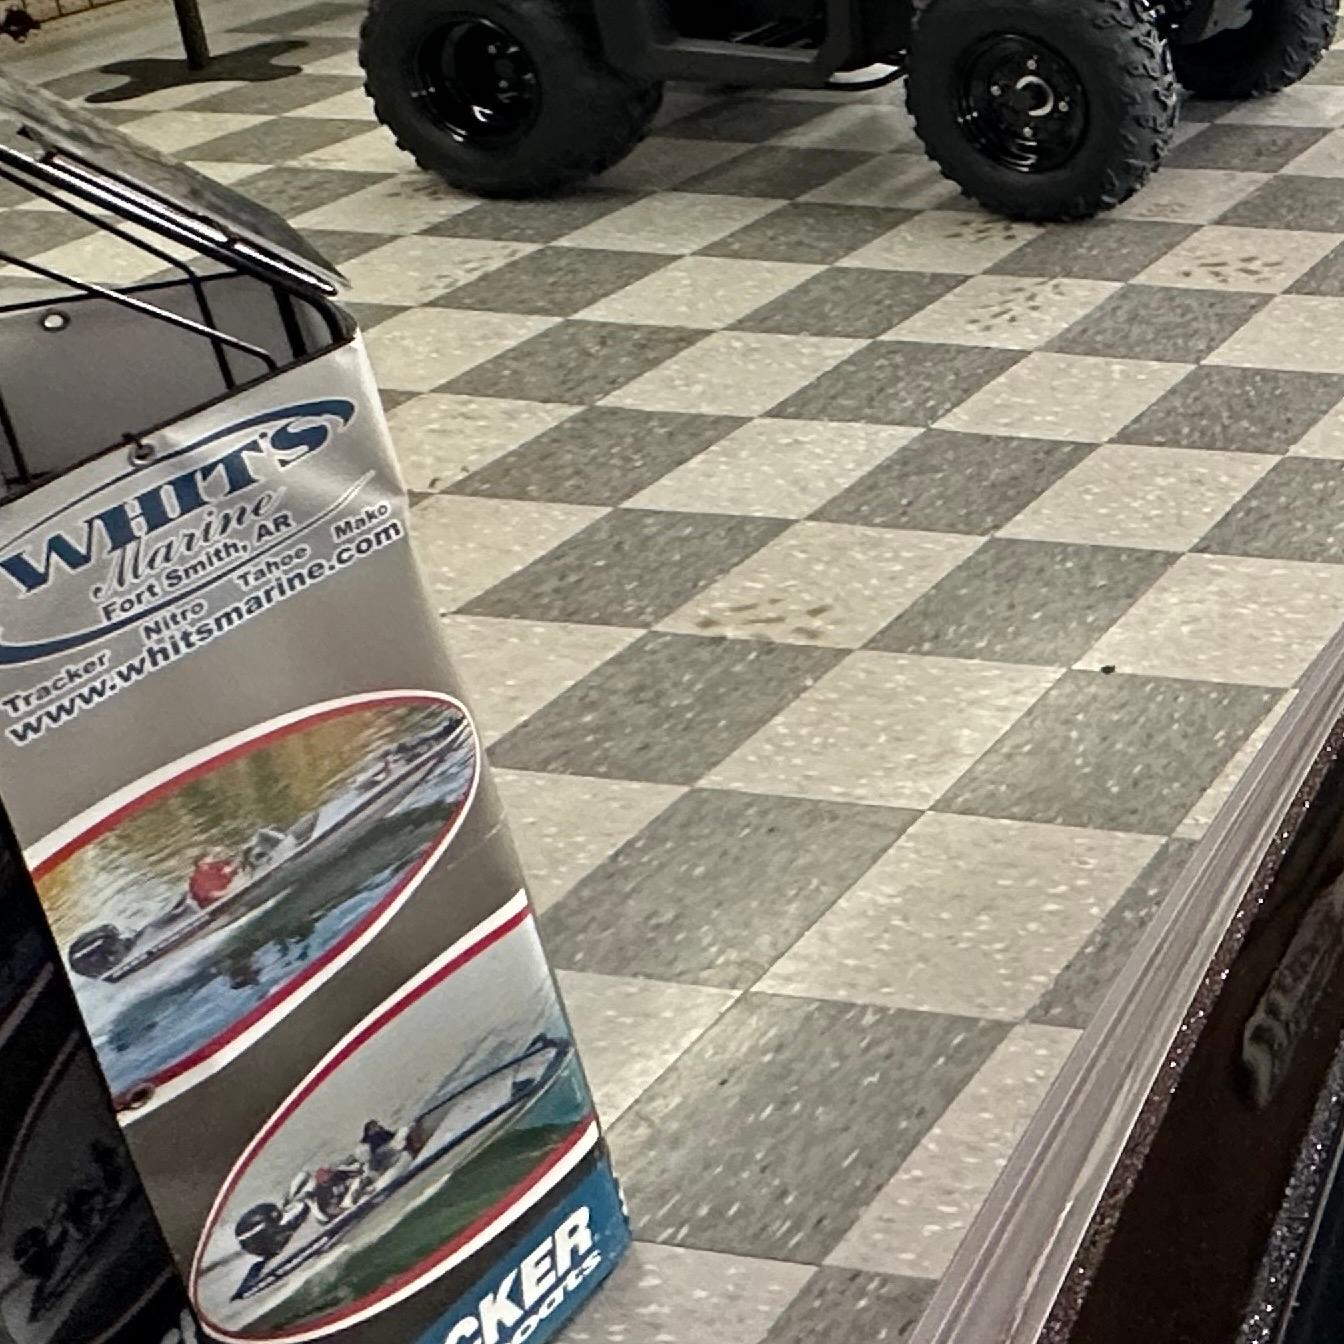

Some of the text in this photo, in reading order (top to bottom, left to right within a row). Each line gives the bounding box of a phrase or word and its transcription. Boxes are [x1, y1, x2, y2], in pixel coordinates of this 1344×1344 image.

[0, 415, 332, 598] WHIT'S
[92, 487, 287, 602] Marine
[101, 512, 294, 624] Fort Smith, AR
[3, 502, 391, 720] Tracker Nitro Tahoe Mako
[6, 519, 402, 747] www.whitsmarine.com
